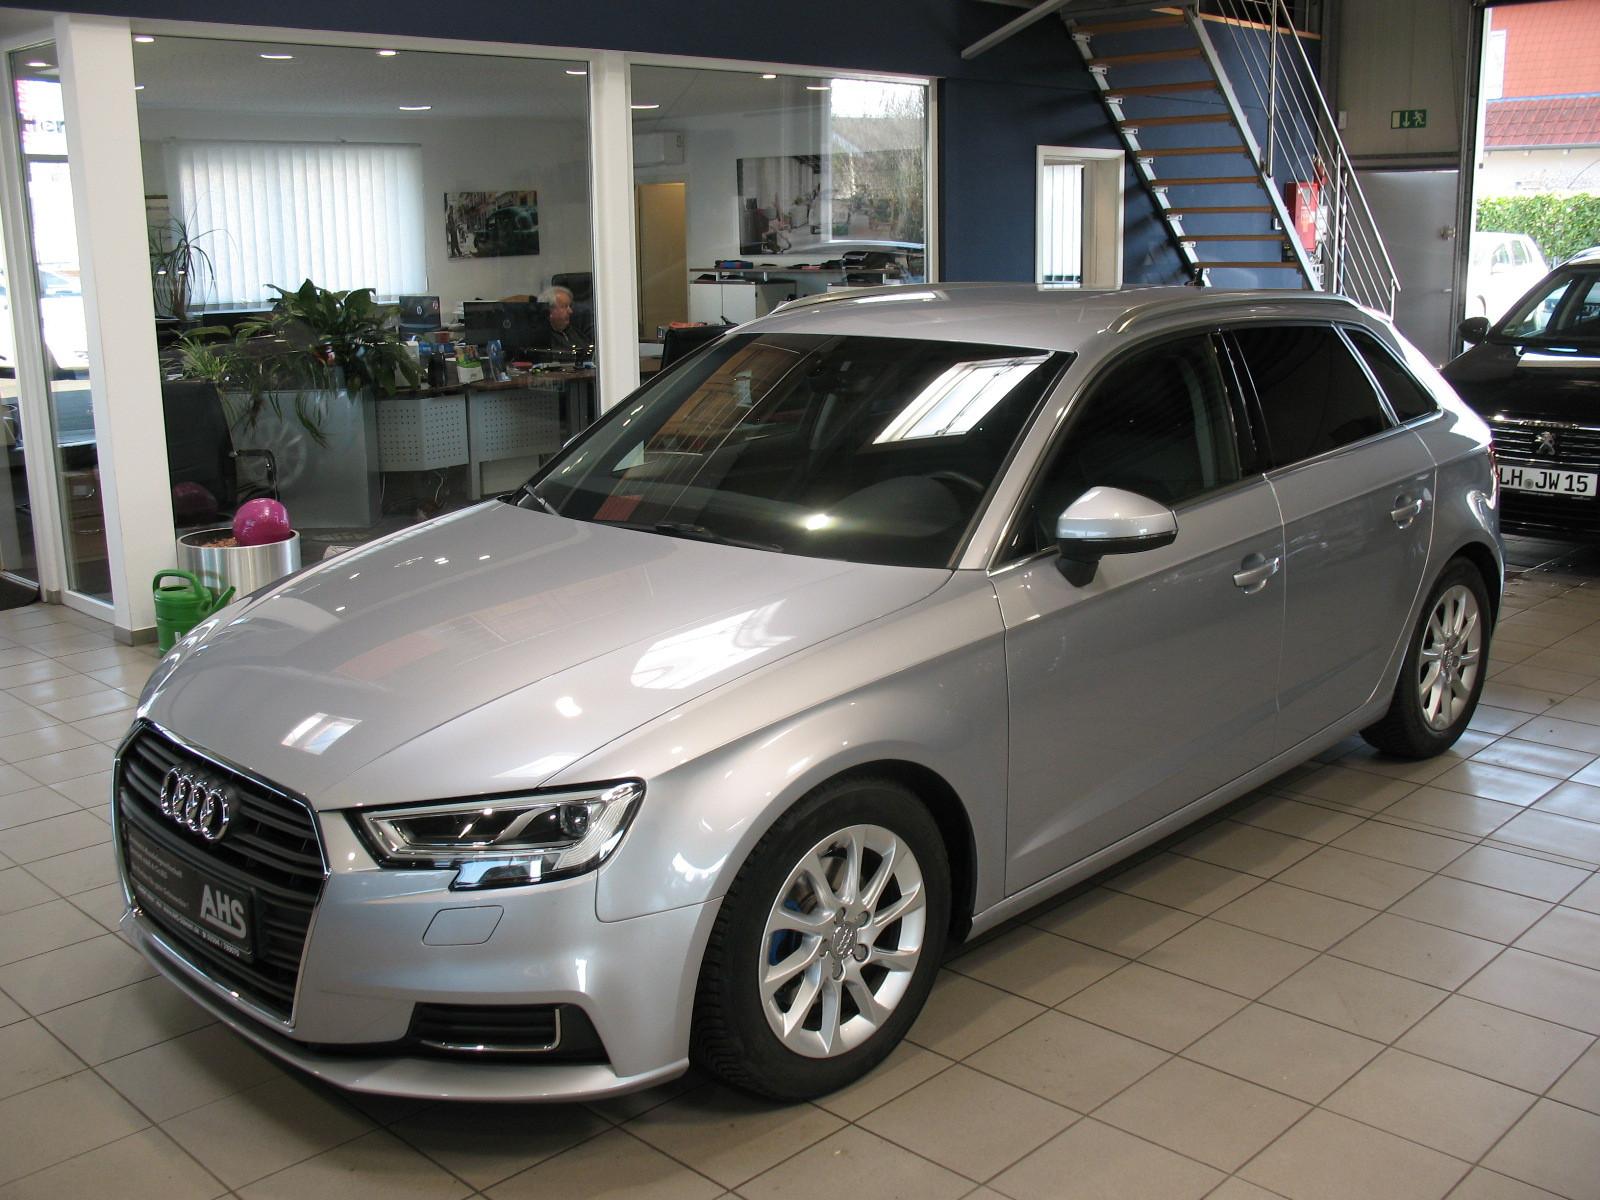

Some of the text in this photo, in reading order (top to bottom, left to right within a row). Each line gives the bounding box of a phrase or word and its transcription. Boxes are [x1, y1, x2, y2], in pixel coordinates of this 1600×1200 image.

[1500, 468, 1589, 493] LH JW 15
[201, 884, 247, 938] AHS
